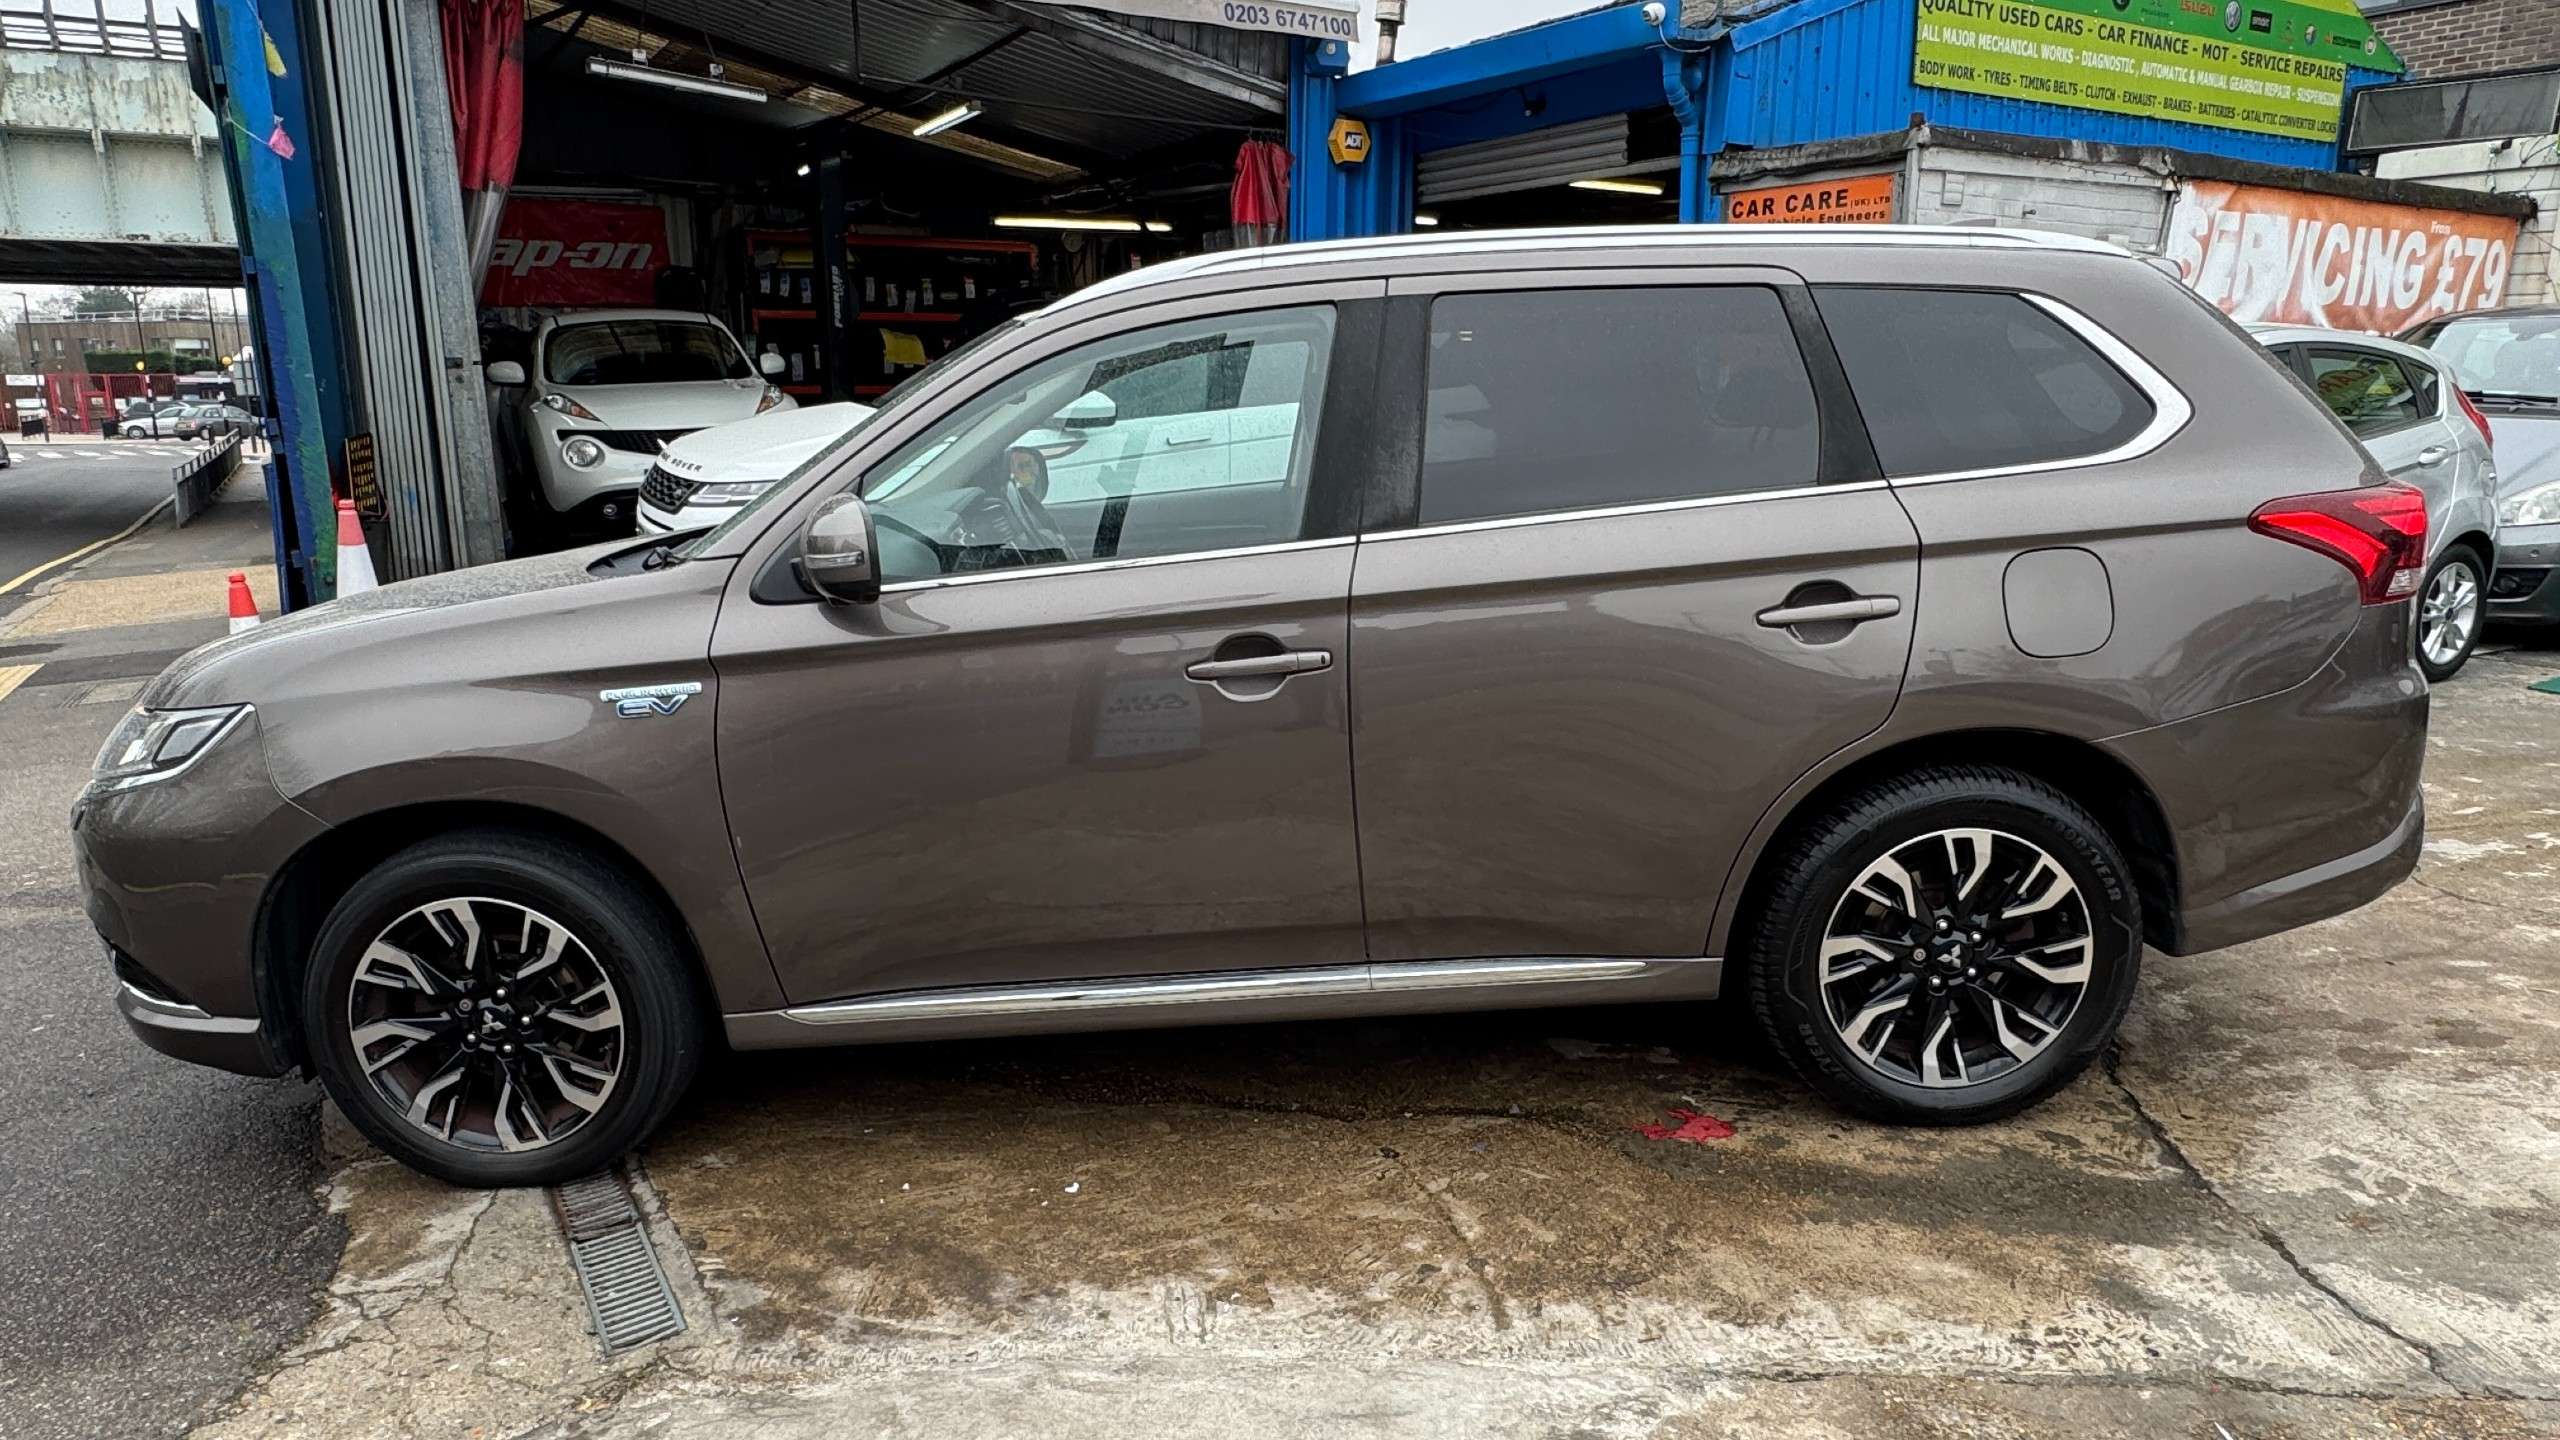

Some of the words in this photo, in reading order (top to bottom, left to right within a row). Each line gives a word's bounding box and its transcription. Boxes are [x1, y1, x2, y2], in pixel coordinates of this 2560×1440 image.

[1224, 3, 1270, 25] 0203
[1275, 9, 1351, 36] 6747100
[1922, 0, 1994, 20] QUALITY
[2000, 6, 2040, 28] USED
[2045, 14, 2083, 36] CARS
[2098, 24, 2126, 44] CAR
[2130, 30, 2189, 55] FINANCE
[2202, 43, 2229, 62] MOT
[2240, 50, 2290, 73] SERVICE
[2294, 61, 2343, 82] REPAIRS
[1921, 24, 1940, 42] ALL
[1942, 27, 1976, 48] MAJOR
[1978, 34, 2038, 58] MECHANICAL
[2040, 44, 2073, 64] WORKS
[2081, 50, 2135, 74] DIAGNOSTIC
[2140, 62, 2188, 83] AUTOMATIC
[2196, 70, 2228, 90] MANUAL
[2229, 76, 2264, 95] GEARBOX
[2264, 82, 2291, 99] REPAIR
[1919, 59, 1944, 76] BODY
[1948, 64, 1975, 81] WORK
[1984, 69, 2011, 86] TYRES
[2019, 75, 2050, 92] TIMING
[2053, 81, 2078, 96] BELTS
[2085, 85, 2115, 101] CLUTCH
[2122, 91, 2157, 108] EXHAUST
[2163, 97, 2192, 113] BRAKES
[2198, 102, 2235, 119] BATTERIES
[2241, 109, 2278, 125] CATALYTIC
[2279, 114, 2316, 131] CONVERTER
[2317, 120, 2337, 134] LOCKS
[1345, 134, 1363, 149] ADT
[1731, 198, 1775, 219] CAR
[1785, 189, 1849, 214] CARE
[1873, 195, 1891, 204] LTD
[1818, 210, 1886, 224] Engineers
[489, 238, 653, 277] ap-on
[2166, 199, 2427, 310] SERVICING
[2429, 233, 2507, 314] £79
[671, 458, 703, 472] ROVER
[616, 694, 689, 719] EV
[2051, 818, 2122, 901] OODYEAR
